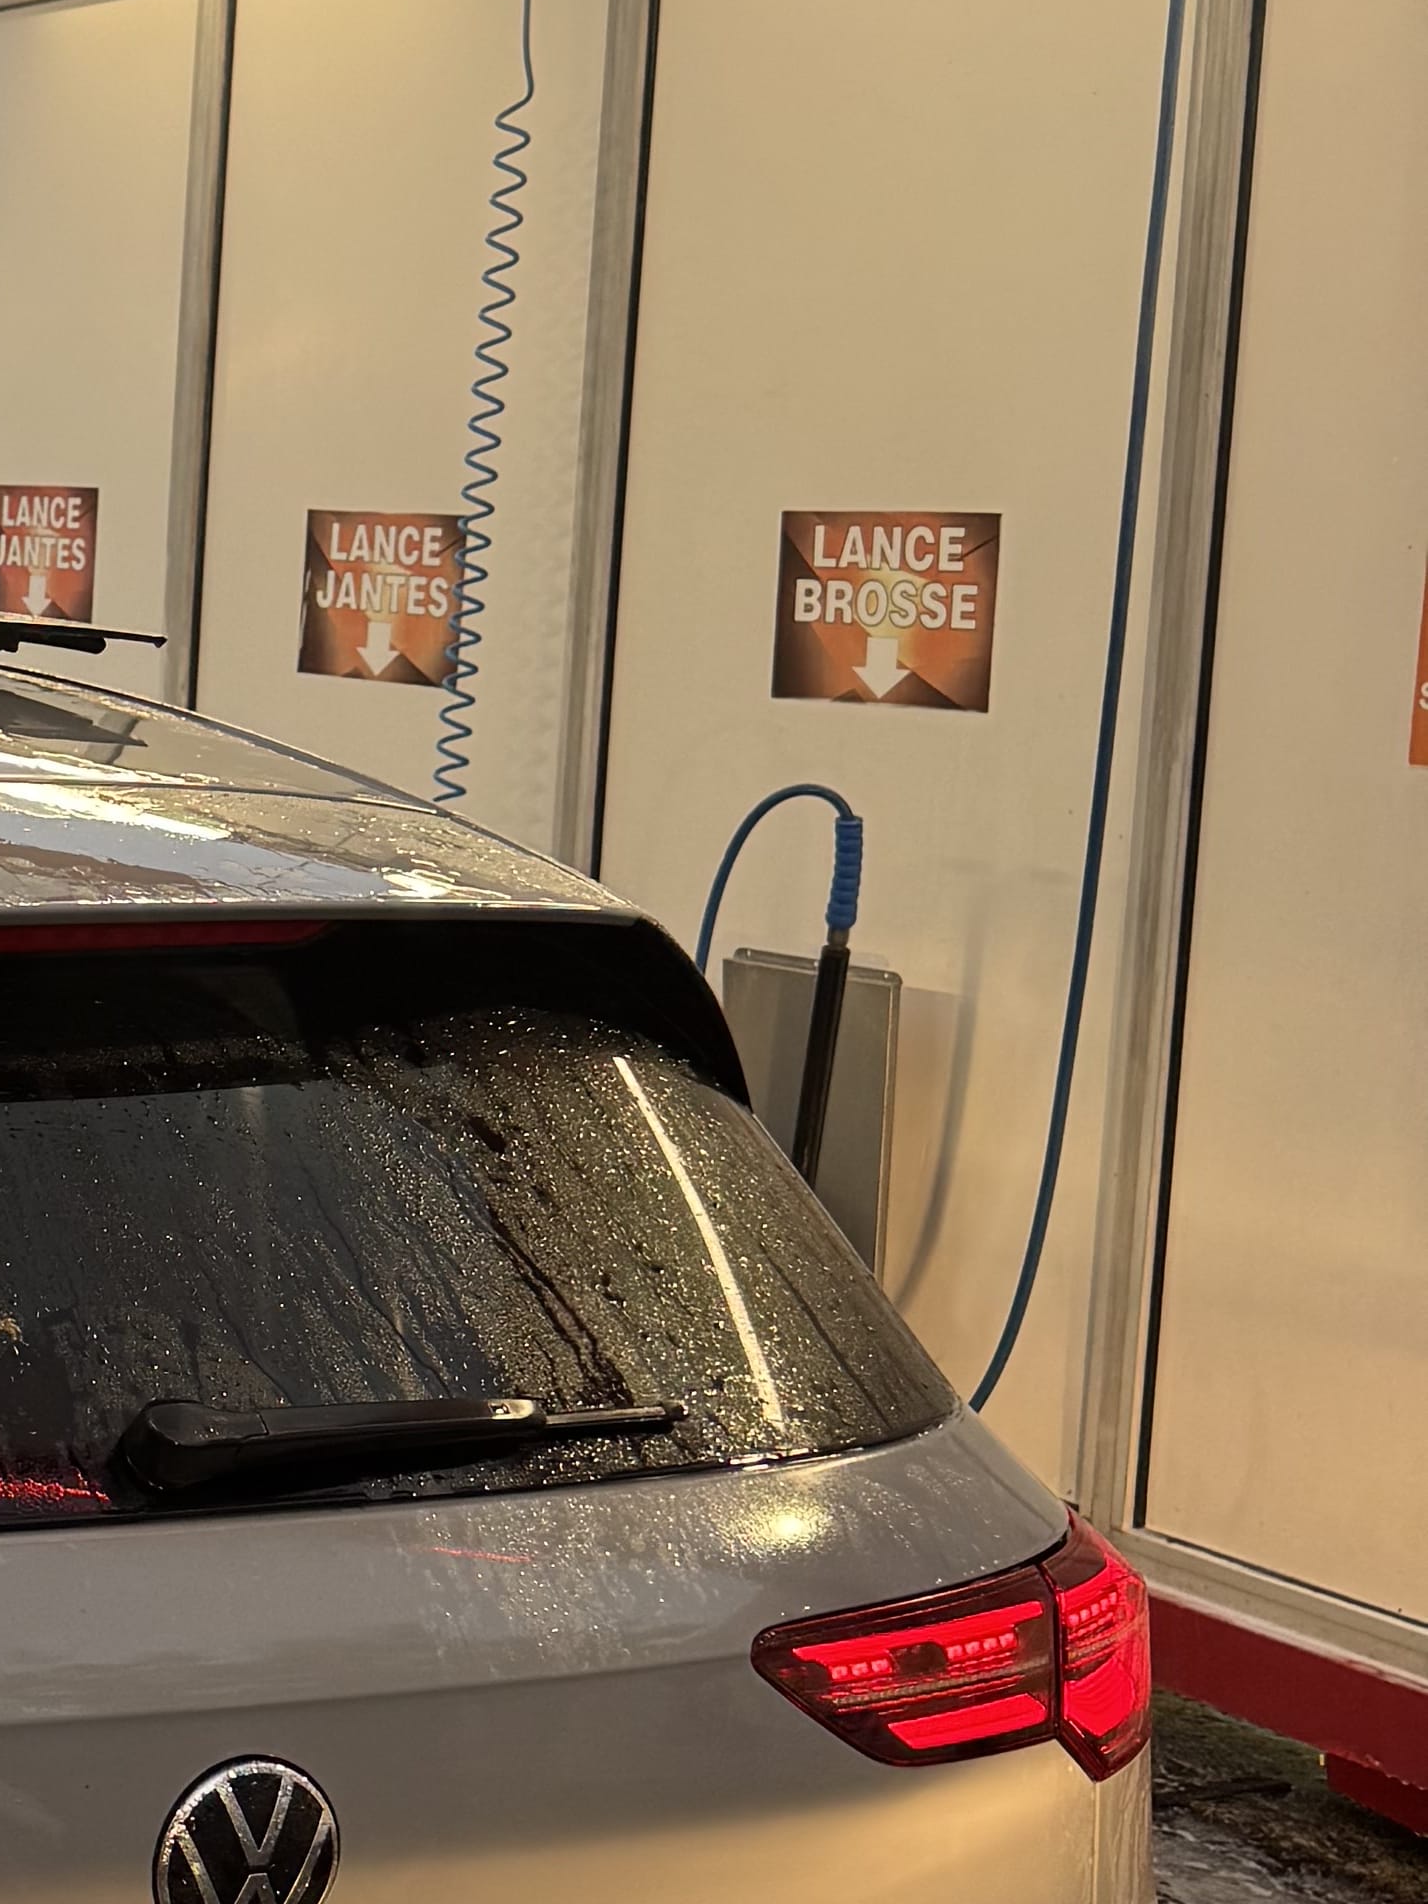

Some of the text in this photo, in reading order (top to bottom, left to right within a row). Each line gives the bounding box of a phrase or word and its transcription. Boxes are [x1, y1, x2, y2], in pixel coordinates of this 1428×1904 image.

[1, 493, 82, 530] LANCE
[329, 522, 443, 567] LANCE
[812, 524, 966, 573] LANCE
[316, 569, 449, 618] JANTES
[793, 578, 979, 631] BROSSE
